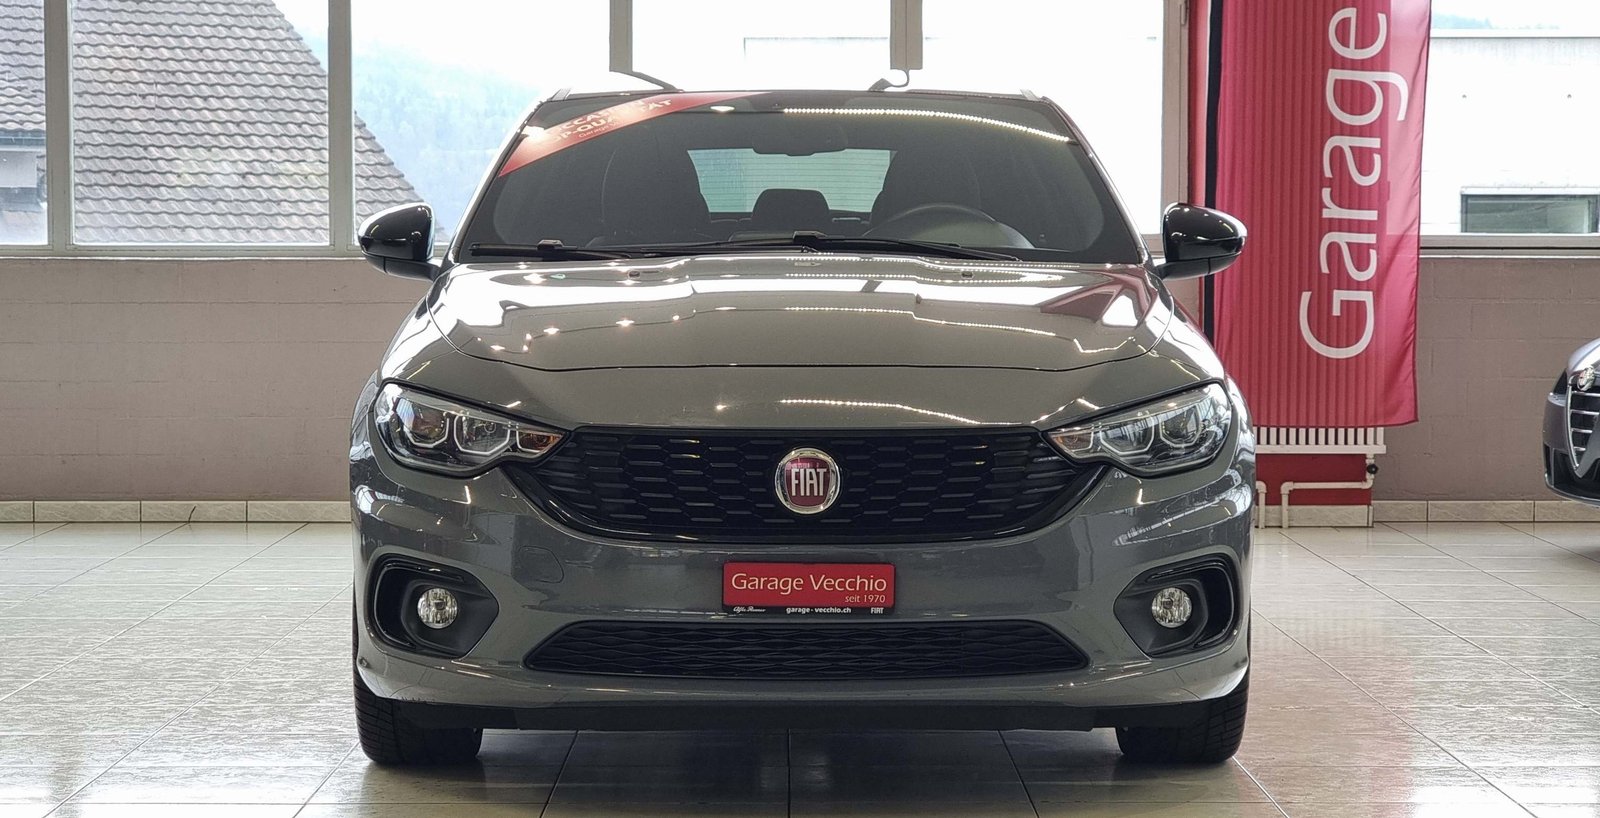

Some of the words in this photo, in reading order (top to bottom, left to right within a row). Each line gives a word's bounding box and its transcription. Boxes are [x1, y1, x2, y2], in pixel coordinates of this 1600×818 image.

[1299, 6, 1409, 359] Garage
[791, 468, 827, 496] FIAT
[731, 573, 804, 595] Garage
[809, 574, 887, 592] Vecchio
[844, 594, 860, 603] seit
[863, 594, 886, 604] 1970
